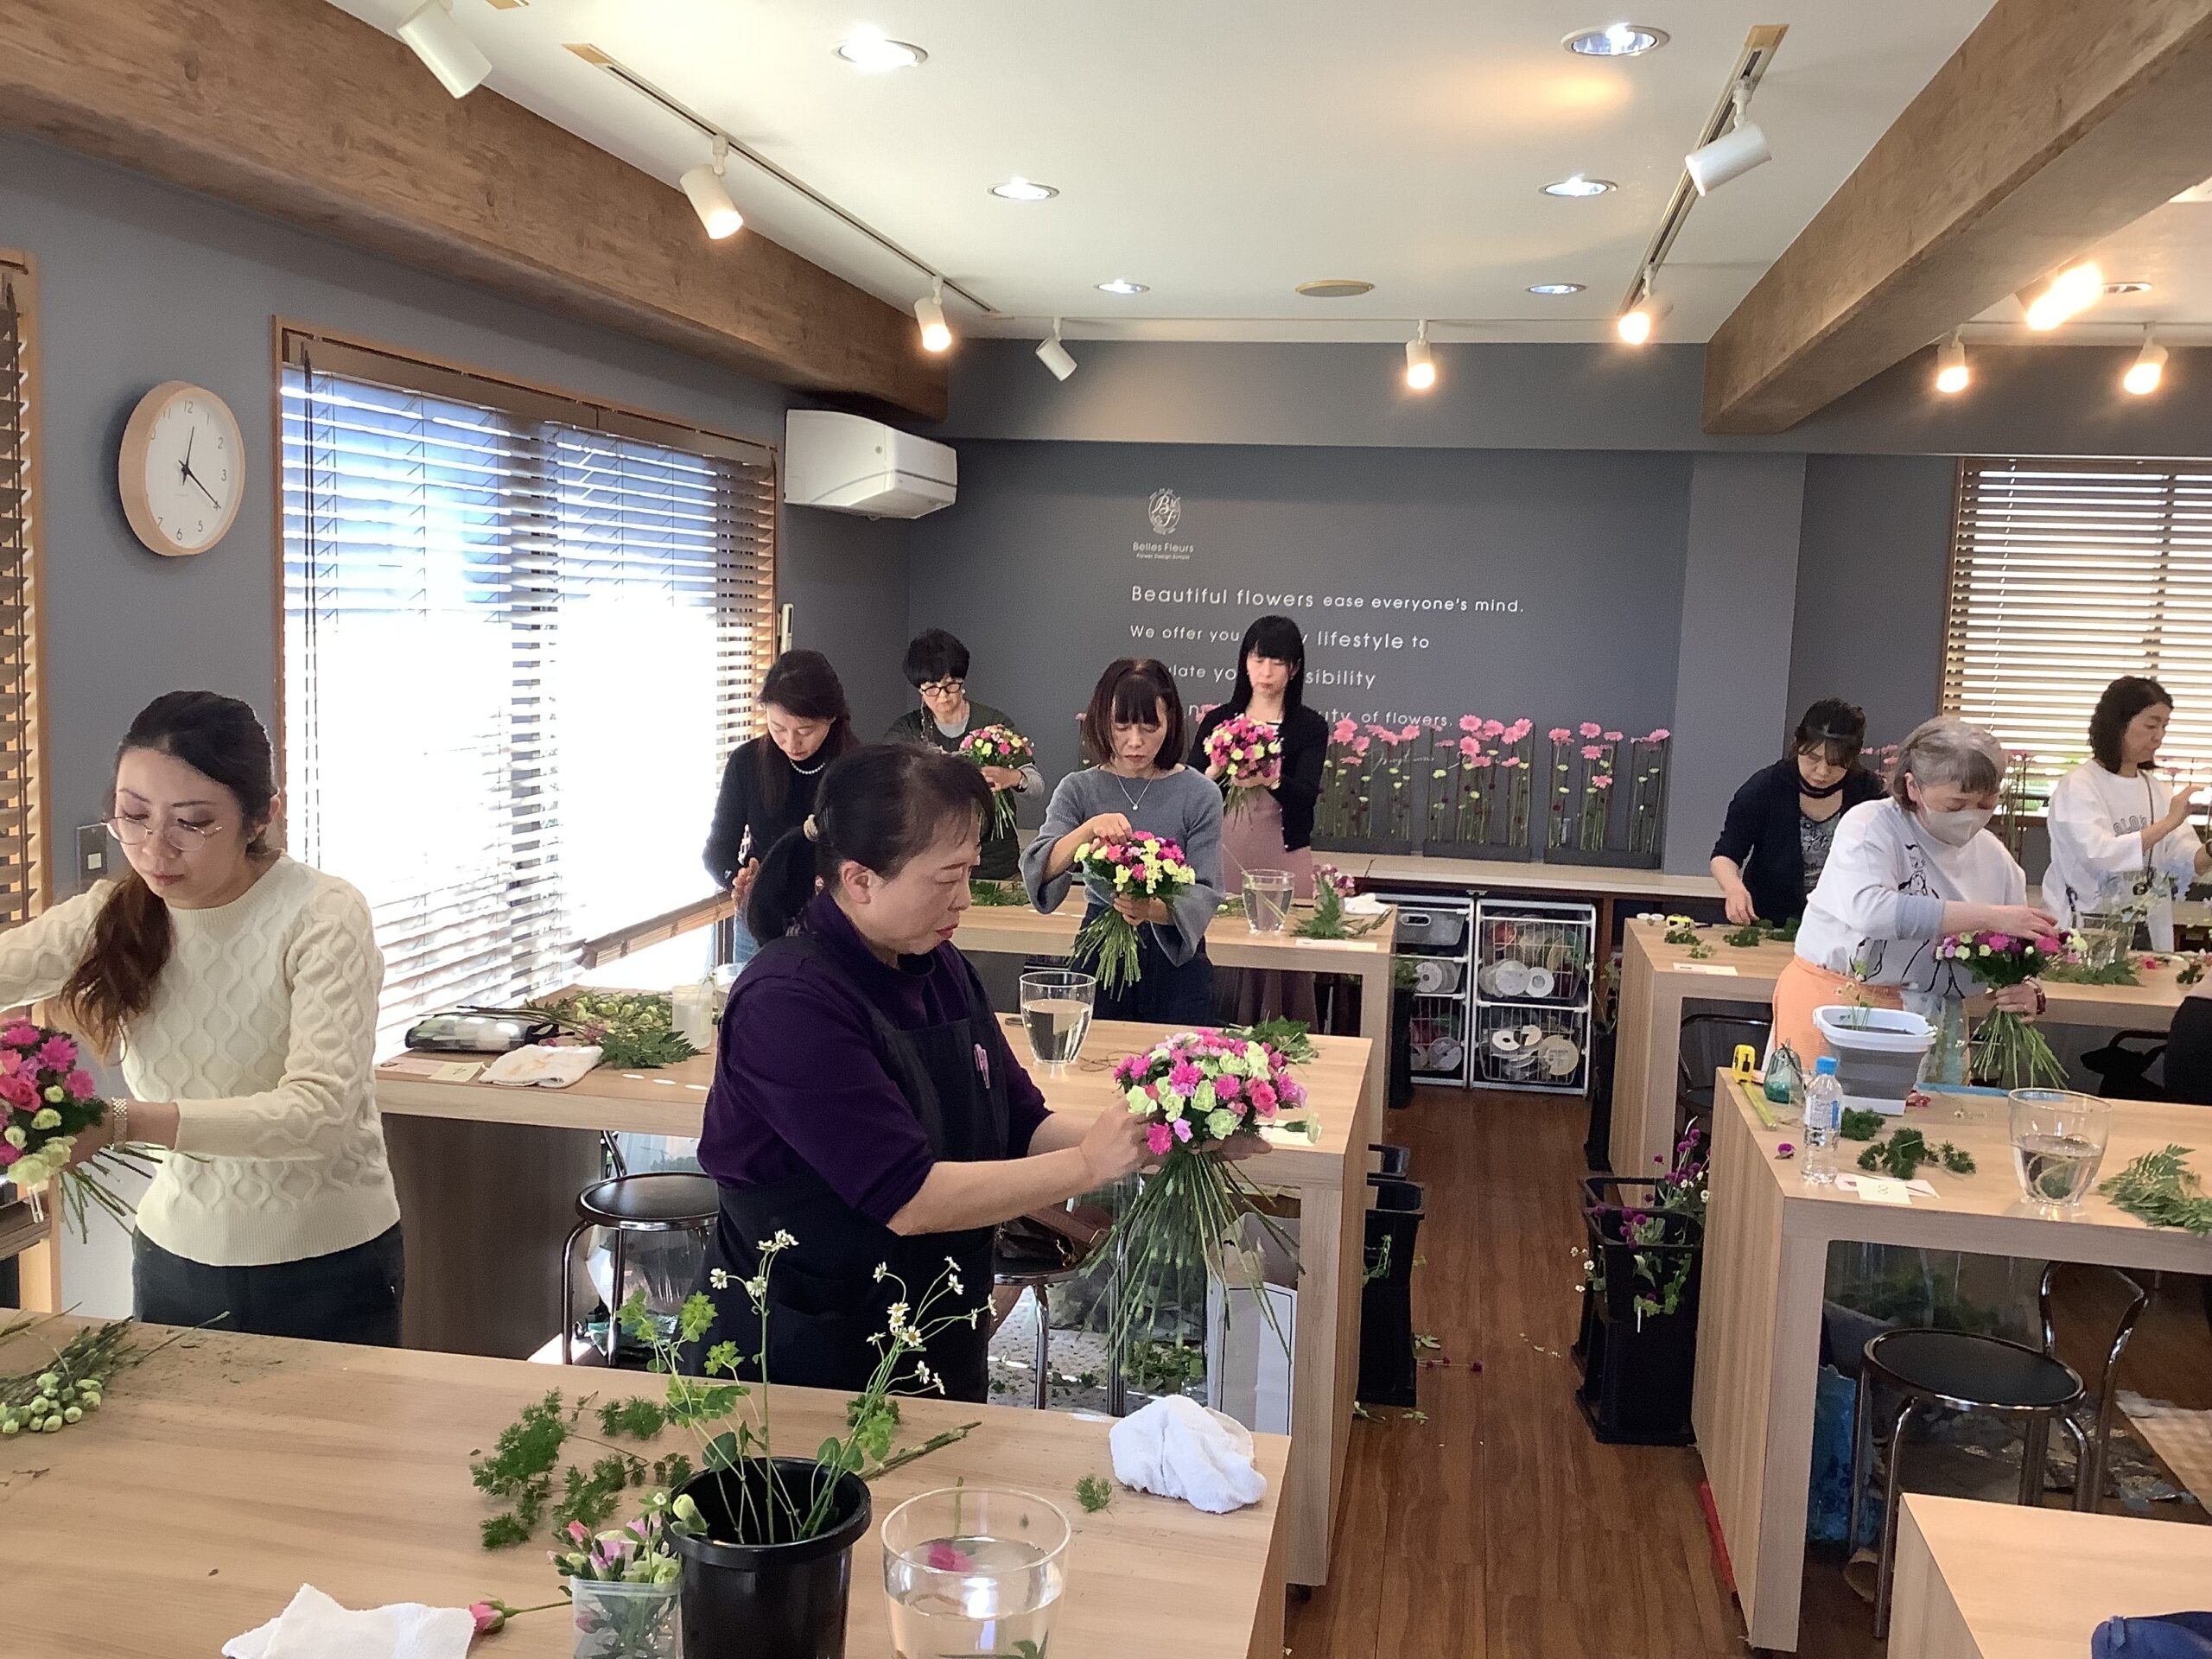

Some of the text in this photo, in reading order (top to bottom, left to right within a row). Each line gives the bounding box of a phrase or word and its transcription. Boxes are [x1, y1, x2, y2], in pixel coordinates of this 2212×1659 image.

[162, 407, 171, 420] 11
[183, 400, 194, 414] 12
[218, 437, 224, 450] 2
[221, 469, 227, 481] 3
[197, 520, 204, 533] 5
[176, 528, 183, 541] 6
[1133, 542, 1194, 553] Belles Fleurs
[1131, 585, 1524, 613] Beautiful flowers ease everyone's mind.
[1130, 625, 1154, 639] We
[1162, 626, 1203, 640] offer
[1317, 631, 1403, 652] lifestyle
[1412, 636, 1430, 649] to
[1168, 664, 1376, 690] late yo sibility
[1361, 711, 1378, 723] of
